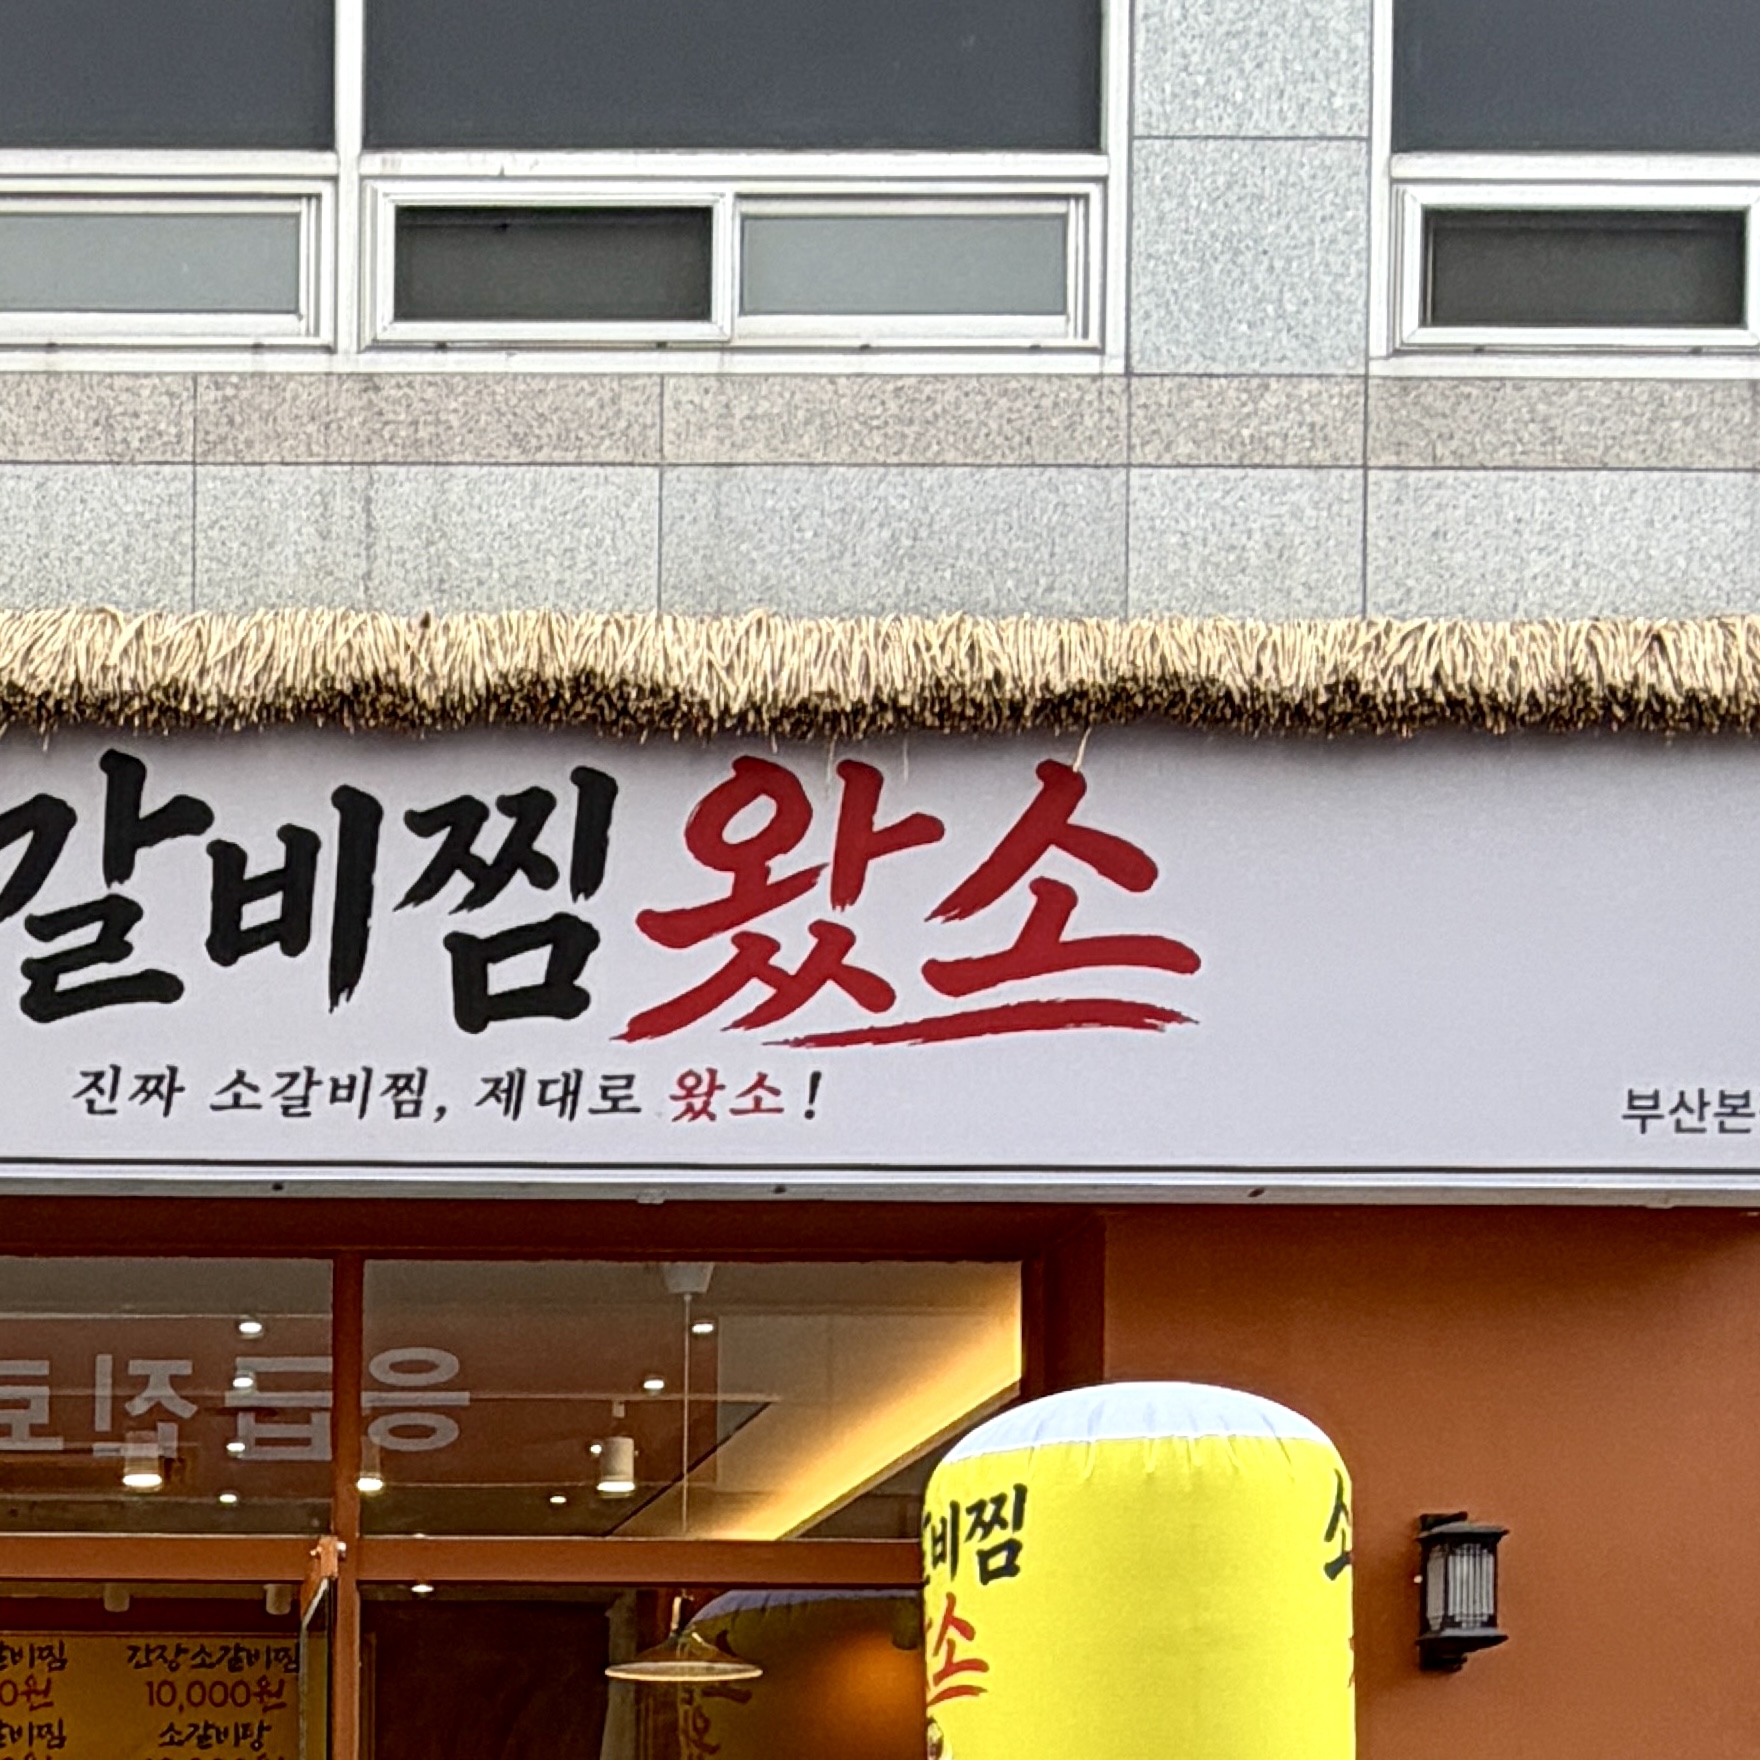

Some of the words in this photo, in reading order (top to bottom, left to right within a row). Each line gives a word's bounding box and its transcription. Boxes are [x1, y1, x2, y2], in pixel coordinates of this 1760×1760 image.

[71, 1066, 185, 1118] 진짜
[209, 1064, 448, 1123] 소갈비찜,
[475, 1066, 641, 1119] 제대로
[1621, 1087, 1760, 1135] 부산본
[924, 1483, 1028, 1586] 비찜
[926, 1591, 990, 1706] 소
[145, 1673, 287, 1714] 10,000원
